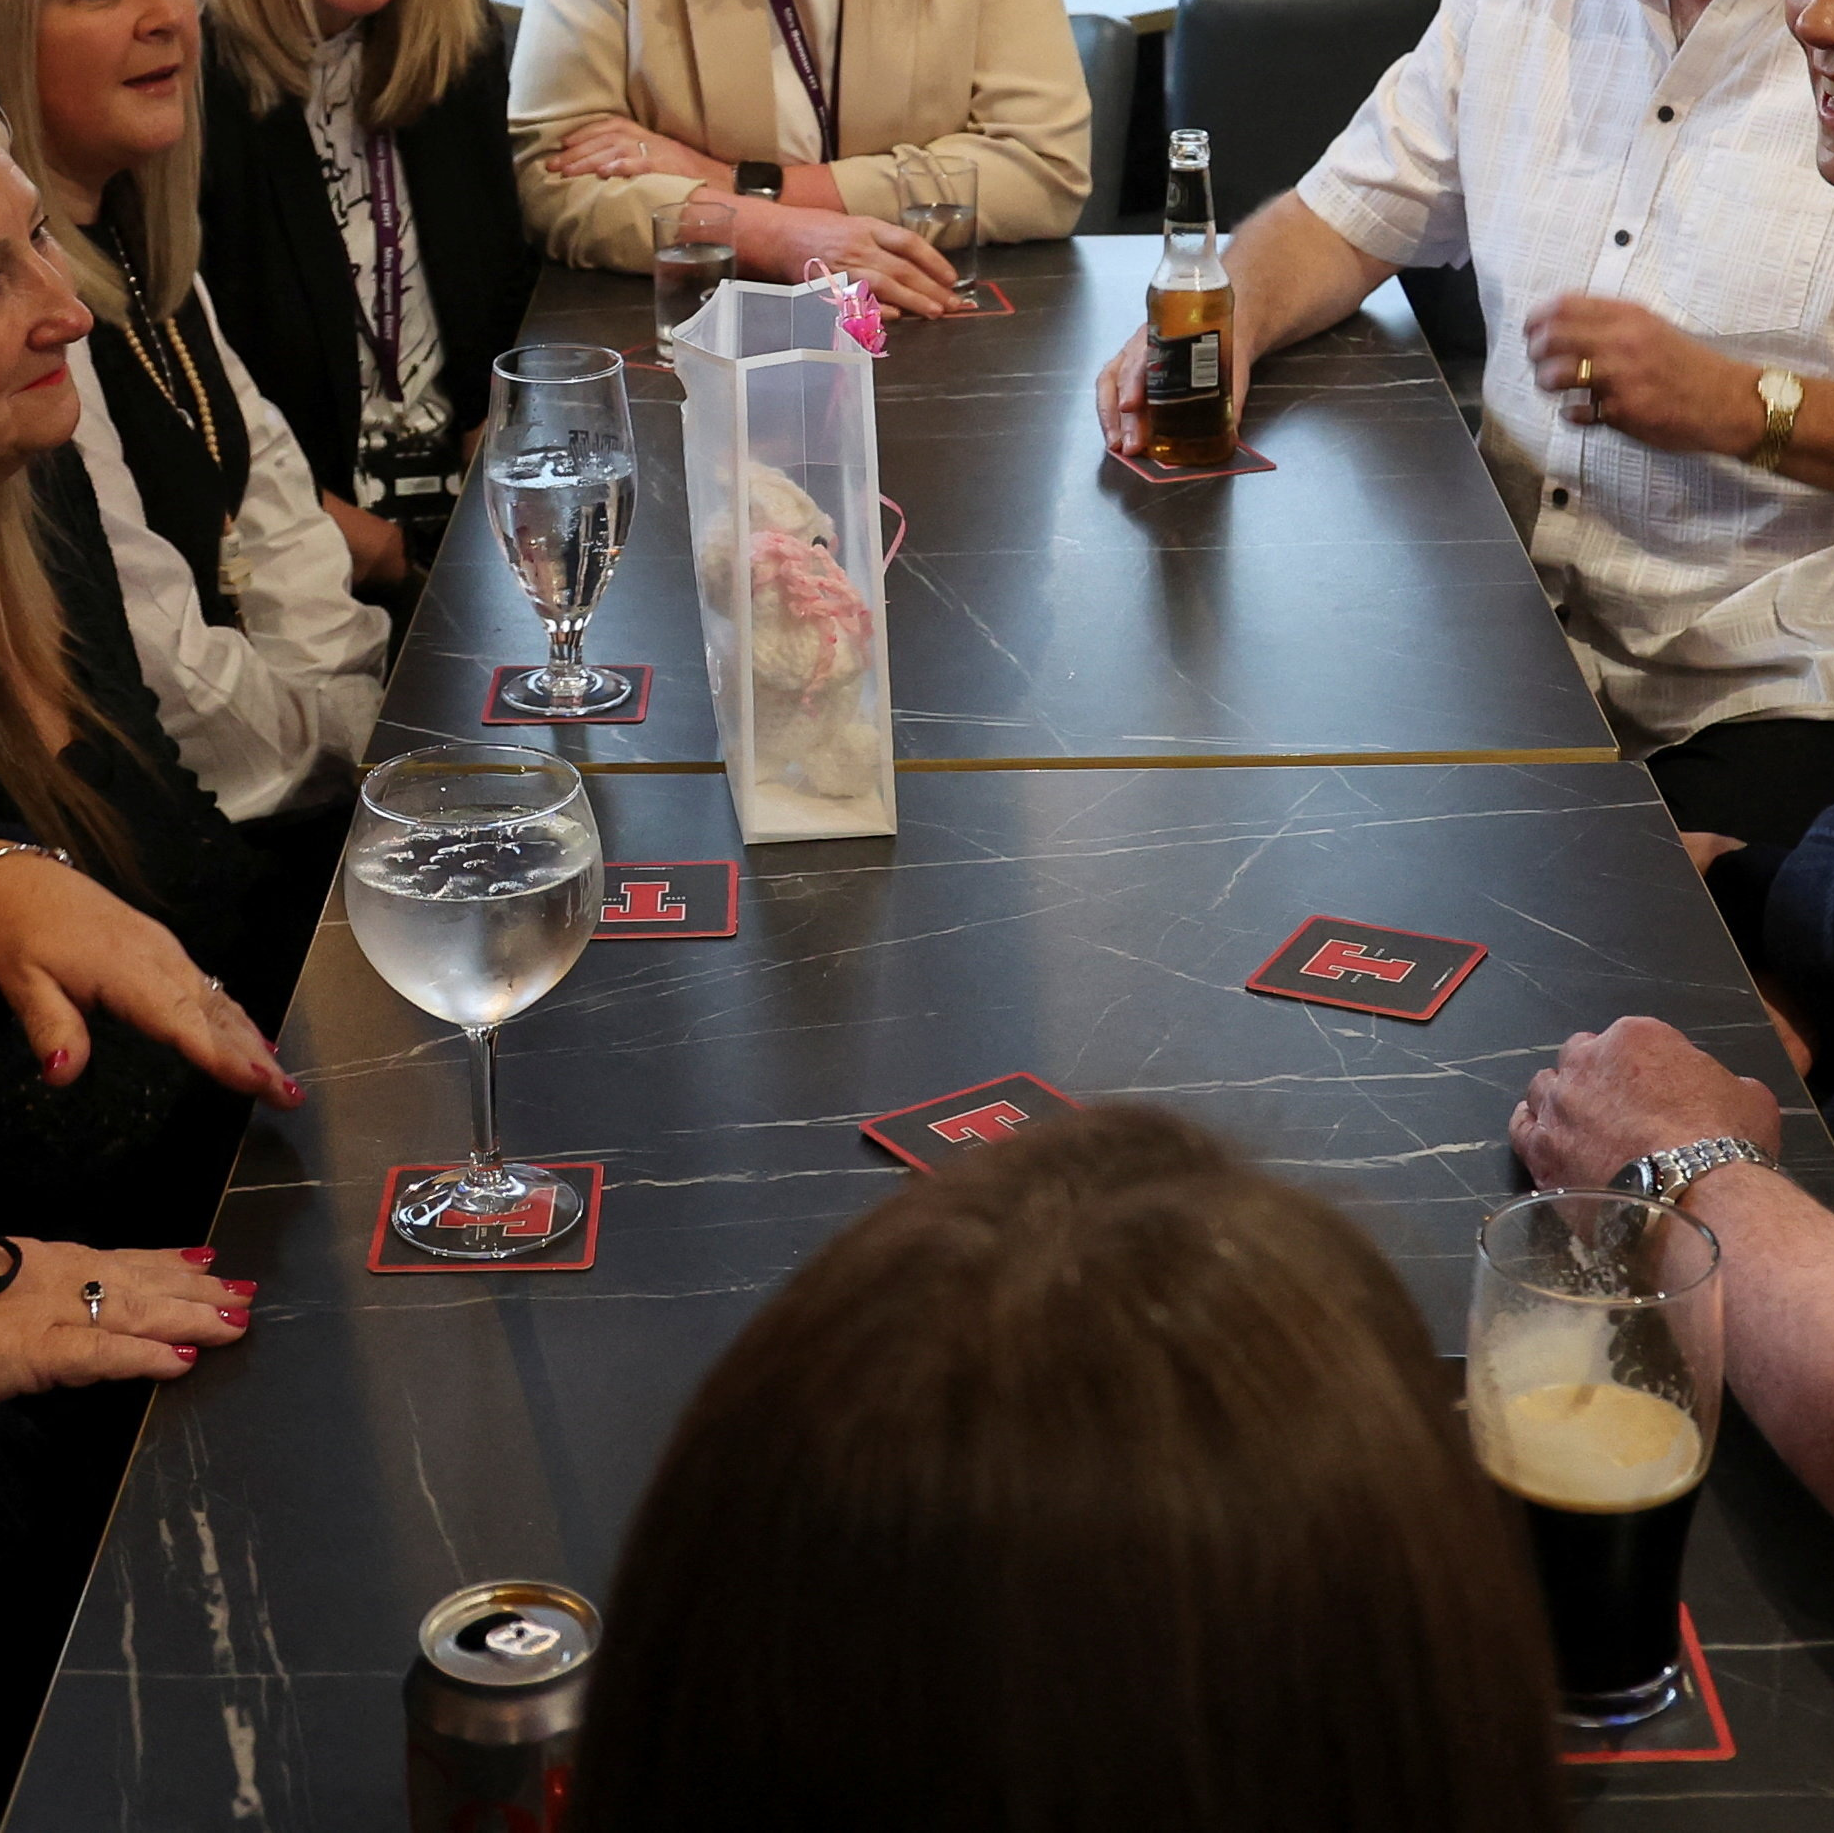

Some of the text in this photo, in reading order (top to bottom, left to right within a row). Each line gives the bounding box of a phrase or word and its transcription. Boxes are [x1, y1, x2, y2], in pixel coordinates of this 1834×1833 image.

[382, 245, 395, 270] Mrs
[599, 880, 686, 923] T
[1299, 938, 1417, 984] T
